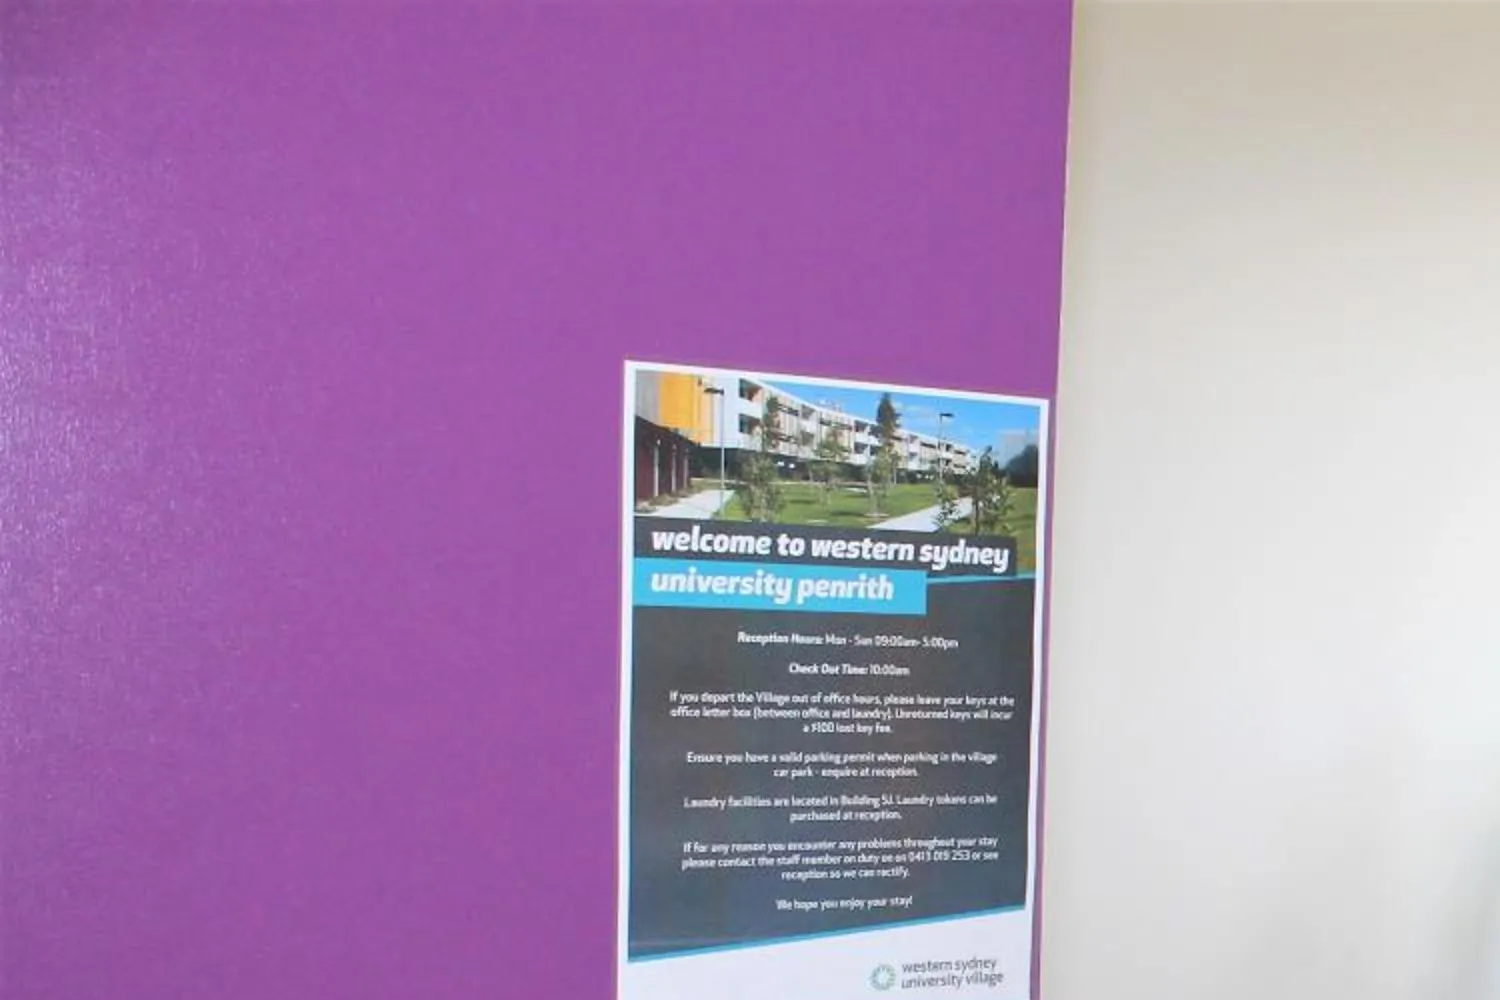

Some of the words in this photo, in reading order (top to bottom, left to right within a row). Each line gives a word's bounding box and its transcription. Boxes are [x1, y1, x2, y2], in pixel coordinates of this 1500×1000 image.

[652, 526, 770, 555] welcome
[776, 533, 805, 557] to
[811, 539, 913, 560] western
[919, 539, 1009, 572] sydney
[651, 566, 791, 602] university
[796, 575, 893, 605] penrith
[738, 631, 789, 646] Reception
[826, 634, 846, 645] Mon
[855, 636, 872, 645] Sun
[790, 662, 818, 673] Check
[822, 664, 839, 674] Out
[670, 690, 677, 701] If
[680, 693, 699, 704] you
[702, 692, 735, 705] depart
[738, 692, 754, 703] the
[756, 692, 790, 706] Village
[792, 694, 808, 703] out
[811, 693, 821, 703] of
[824, 693, 850, 704] office
[884, 694, 915, 706] please
[917, 695, 941, 705] leave
[944, 696, 963, 707] your
[966, 696, 987, 708] keys
[989, 697, 997, 705] at
[1000, 696, 1014, 706] the
[670, 707, 699, 717] office
[702, 707, 730, 717] letter
[733, 707, 751, 717] box
[754, 707, 800, 720] (between
[802, 708, 829, 718] office
[831, 708, 850, 718] and
[896, 709, 948, 719] Unreturned
[950, 710, 971, 721] keys
[974, 710, 988, 719] will
[836, 724, 854, 733] lost
[857, 723, 873, 735] key
[687, 752, 723, 763] Ensure
[725, 753, 743, 765] you
[746, 752, 769, 763] have
[779, 752, 802, 763] valid
[804, 752, 840, 764] parking
[843, 752, 875, 764] permit
[877, 753, 902, 763] when
[904, 752, 939, 764] parking
[952, 752, 966, 762] the
[968, 752, 997, 764] village
[774, 768, 789, 777] car
[791, 767, 813, 779] park
[821, 768, 858, 778] enquire
[860, 768, 870, 777] at
[684, 797, 726, 810] Laundry
[728, 796, 772, 807] facilities
[774, 798, 789, 806] are
[792, 796, 828, 806] located
[841, 794, 880, 807] Building
[897, 795, 934, 807] Laundry
[937, 795, 966, 804] tokens
[969, 795, 984, 803] can
[987, 794, 997, 803] be
[790, 810, 840, 823] purchased
[843, 811, 852, 820] at
[684, 842, 693, 853] If
[694, 842, 708, 853] for
[712, 844, 729, 854] any
[732, 843, 766, 851] reason
[768, 842, 785, 853] you
[787, 841, 836, 851] encounter
[838, 841, 855, 851] any
[857, 838, 901, 849] problems
[904, 837, 954, 849] throughout
[958, 838, 976, 847] your
[979, 837, 998, 846] stay
[682, 857, 716, 871] please
[718, 857, 755, 868] contact
[758, 856, 774, 867] the
[777, 854, 800, 865] staff
[802, 855, 841, 865] member
[843, 854, 856, 863] on
[857, 852, 879, 864] duty
[972, 851, 981, 859] or
[983, 851, 998, 859] see
[782, 869, 828, 881] reception
[830, 869, 840, 878] so
[844, 869, 856, 878] we
[858, 868, 874, 877] can
[794, 899, 818, 910] hope
[821, 899, 838, 911] you
[840, 898, 865, 910] enjoy
[867, 897, 887, 909] your
[902, 960, 953, 972] western
[955, 957, 997, 972] sydney
[902, 972, 963, 989] university
[966, 971, 1003, 985] village
